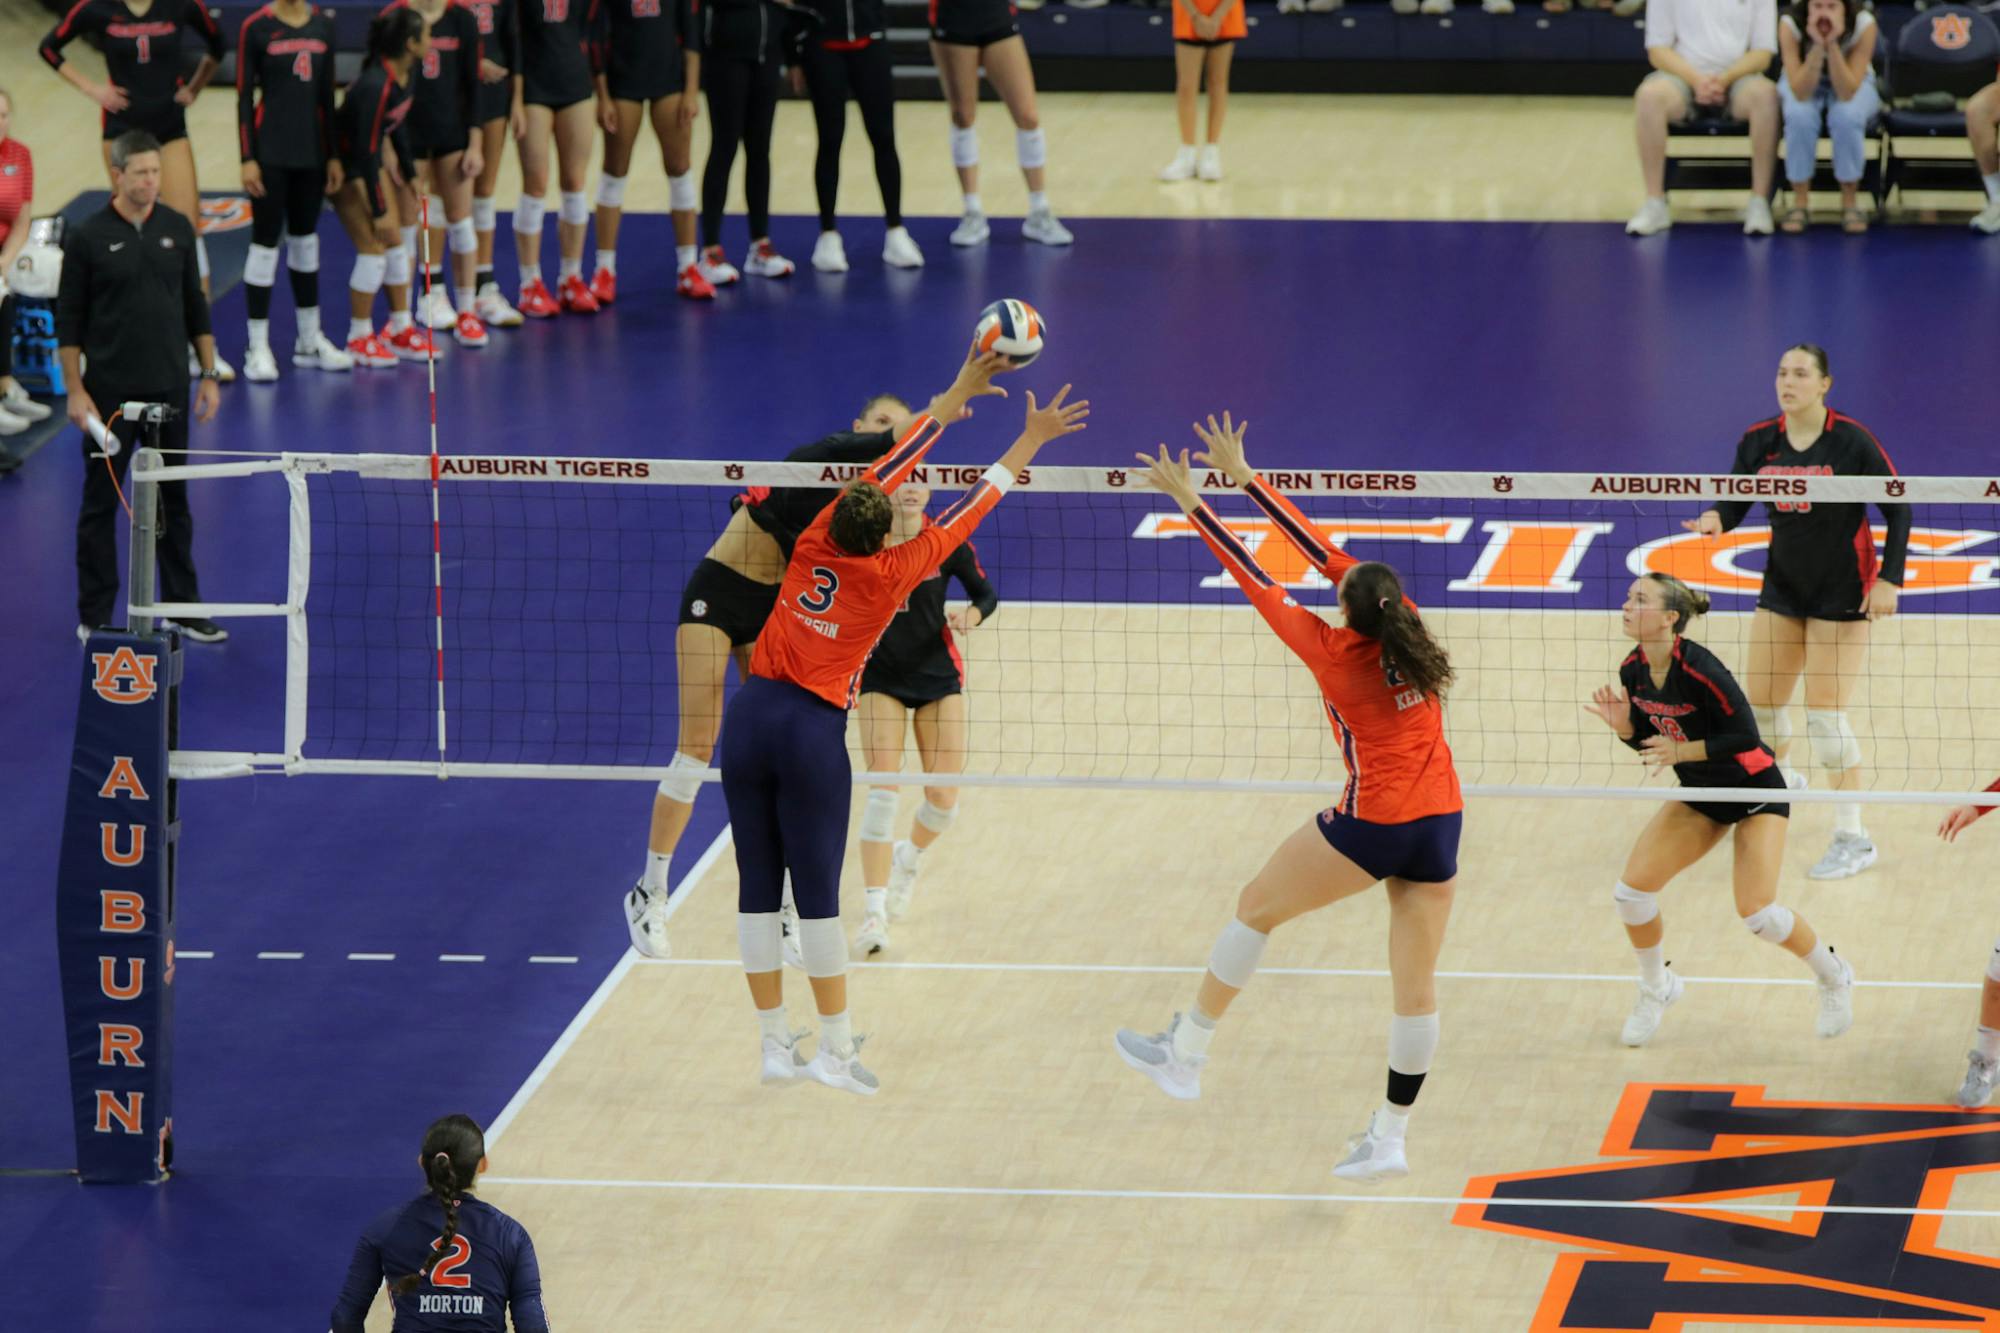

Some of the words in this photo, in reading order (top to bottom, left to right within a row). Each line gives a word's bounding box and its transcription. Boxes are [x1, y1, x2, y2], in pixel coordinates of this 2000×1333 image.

[136, 35, 151, 63] 1
[292, 49, 313, 82] 4
[441, 459, 547, 476] AUBURN
[556, 460, 649, 478] TIGERS
[820, 465, 928, 483] AUN
[936, 467, 1032, 486] TIGS
[1203, 472, 1313, 489] AURN
[1321, 473, 1416, 491] TIGERS
[1590, 477, 1701, 495] AUBURN
[1710, 478, 1808, 496] TIGERS
[797, 566, 840, 614] 3
[95, 756, 149, 1134] AUBURN
[430, 1233, 472, 1288] 2
[419, 1295, 483, 1314] MORTON
